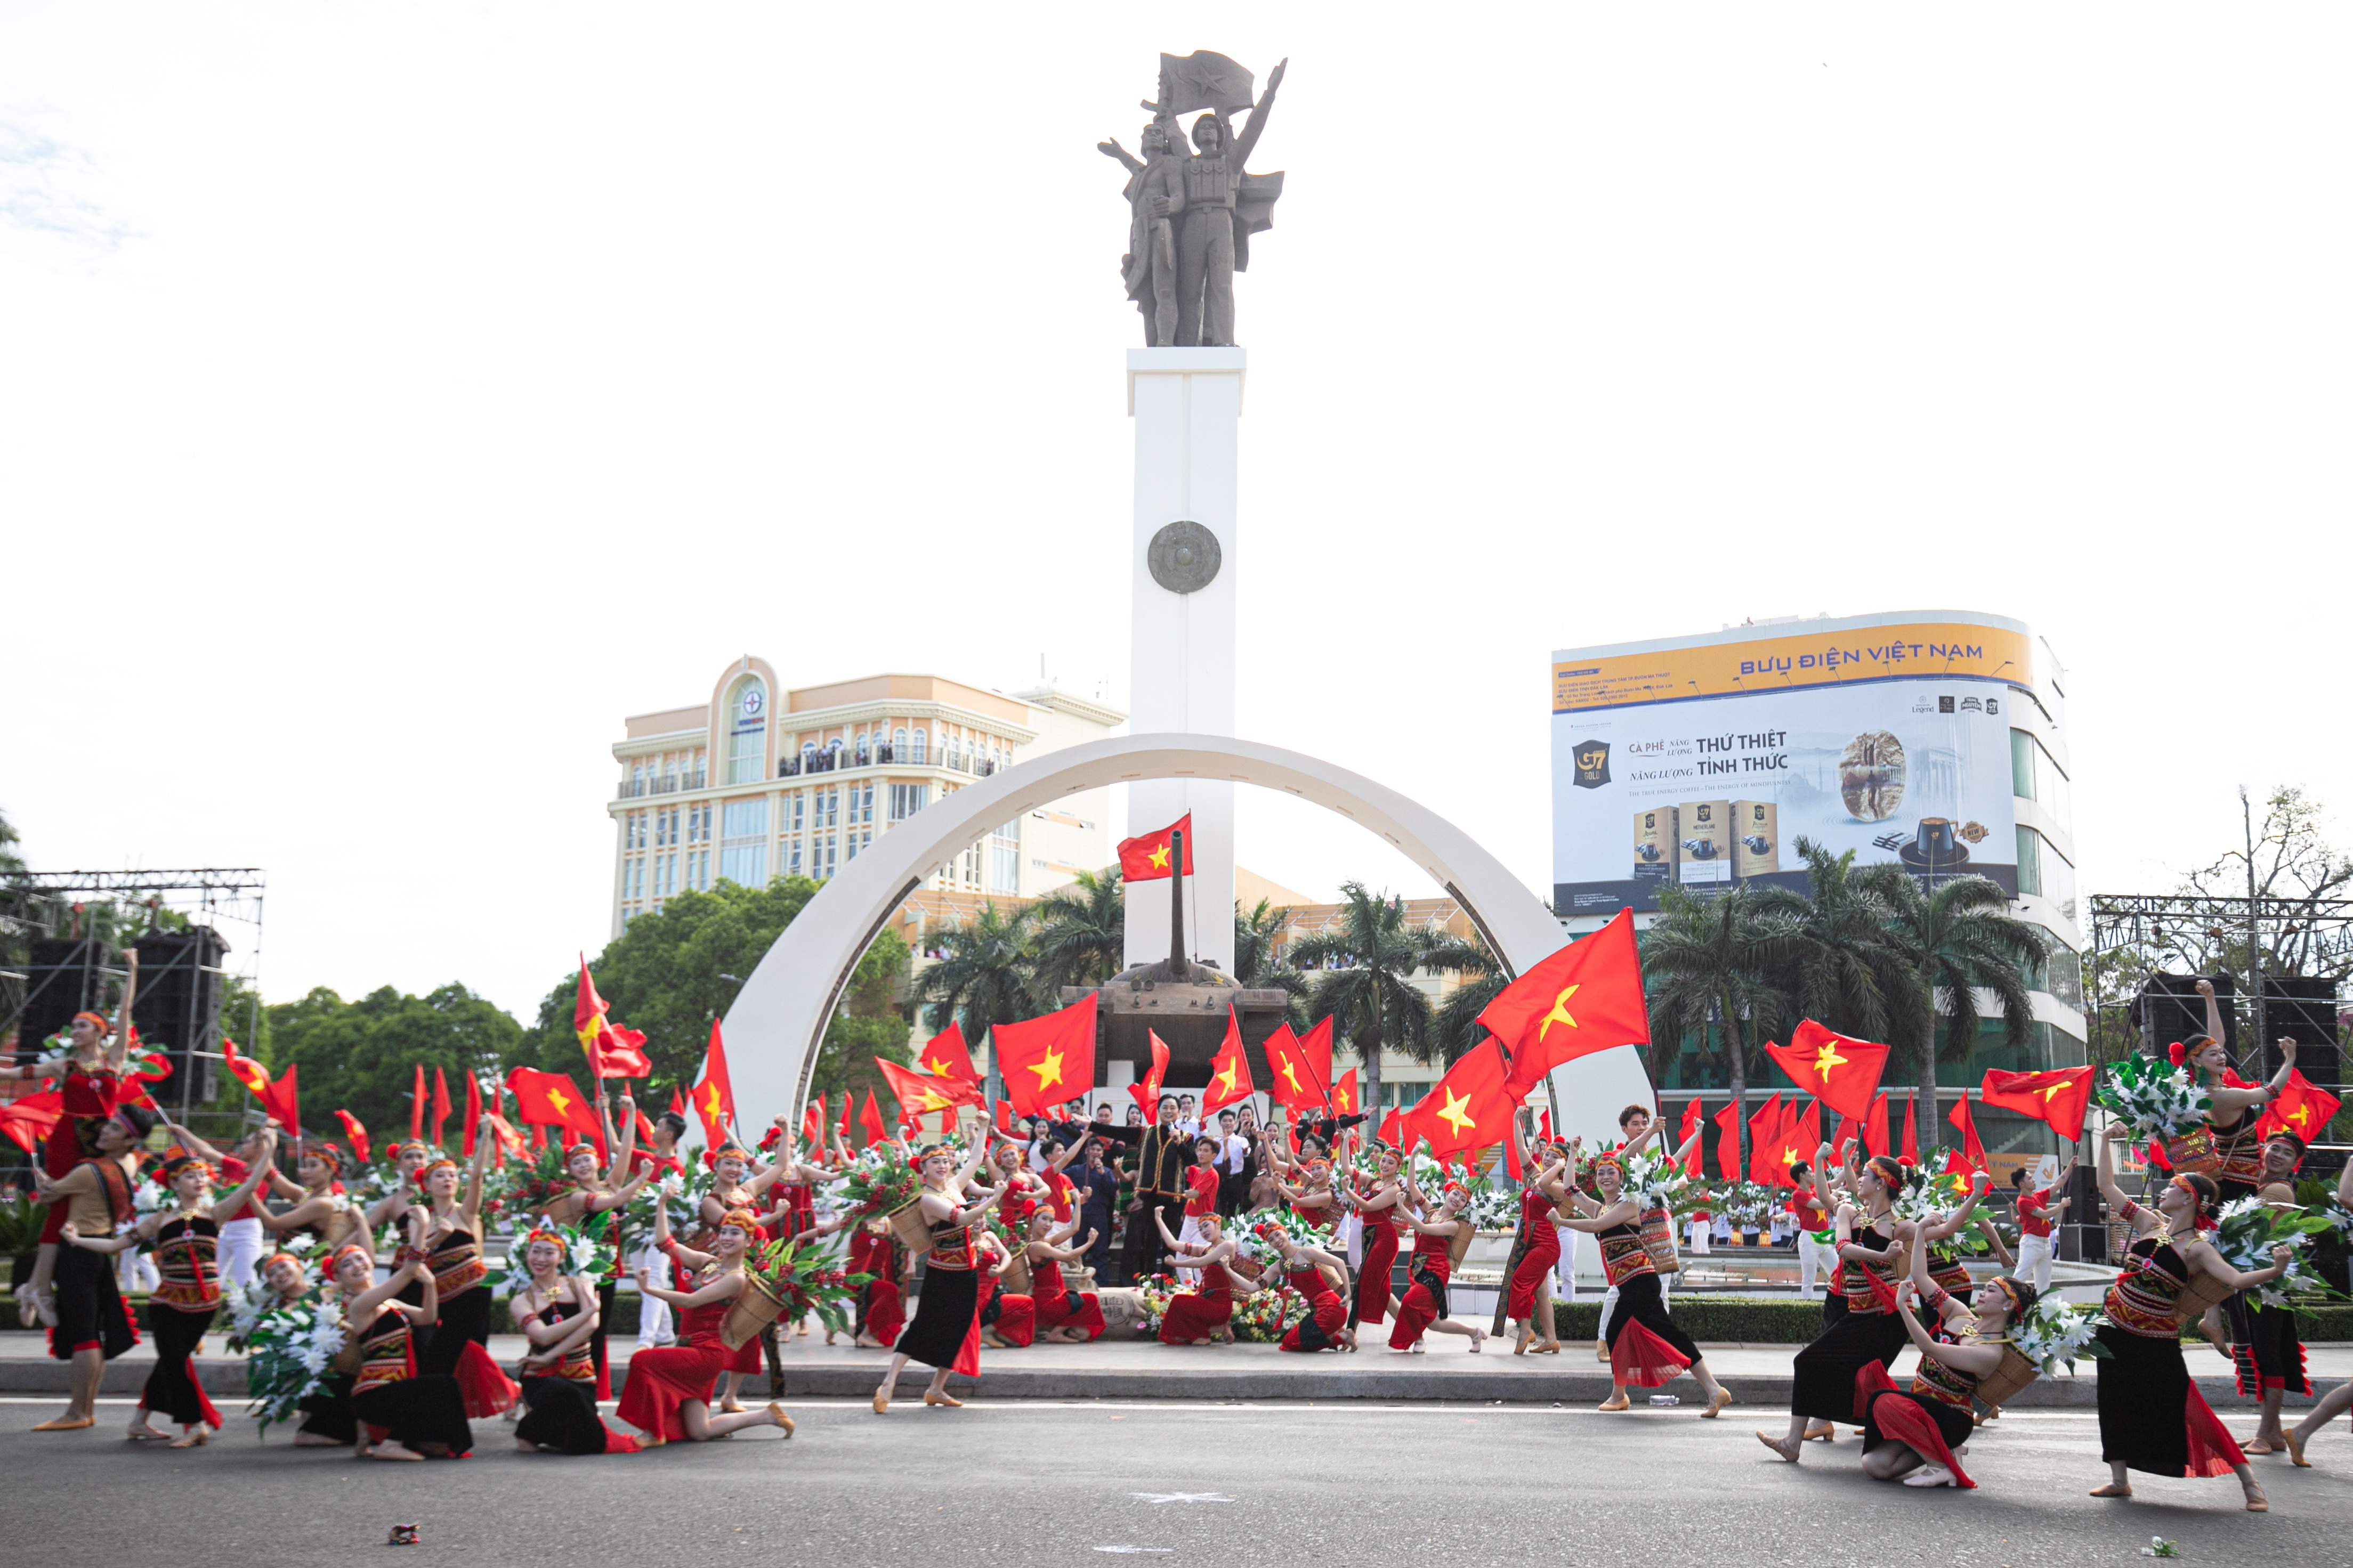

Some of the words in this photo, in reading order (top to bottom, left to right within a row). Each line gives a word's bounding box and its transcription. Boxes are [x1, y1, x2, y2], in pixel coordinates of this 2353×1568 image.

[1741, 656, 1791, 675] BƯU
[1799, 647, 1860, 669] ĐIỆN
[1867, 641, 1923, 662] VIỆT
[1929, 644, 1982, 659] NAM
[1629, 741, 1642, 753] CÀ
[1646, 739, 1664, 751] PHÊ
[1669, 739, 1689, 747] NĂNG
[1696, 733, 1734, 753] THỨ
[1737, 729, 1786, 750] THIỆT
[1667, 748, 1692, 757] LƯỢNG
[1697, 756, 1737, 775] TỈNH
[1742, 752, 1788, 771] THỨC
[1584, 771, 1600, 780] GOLD
[1630, 770, 1656, 781] NĂNG
[1659, 768, 1693, 779] LƯỢNG
[1967, 828, 1979, 837] NEW
